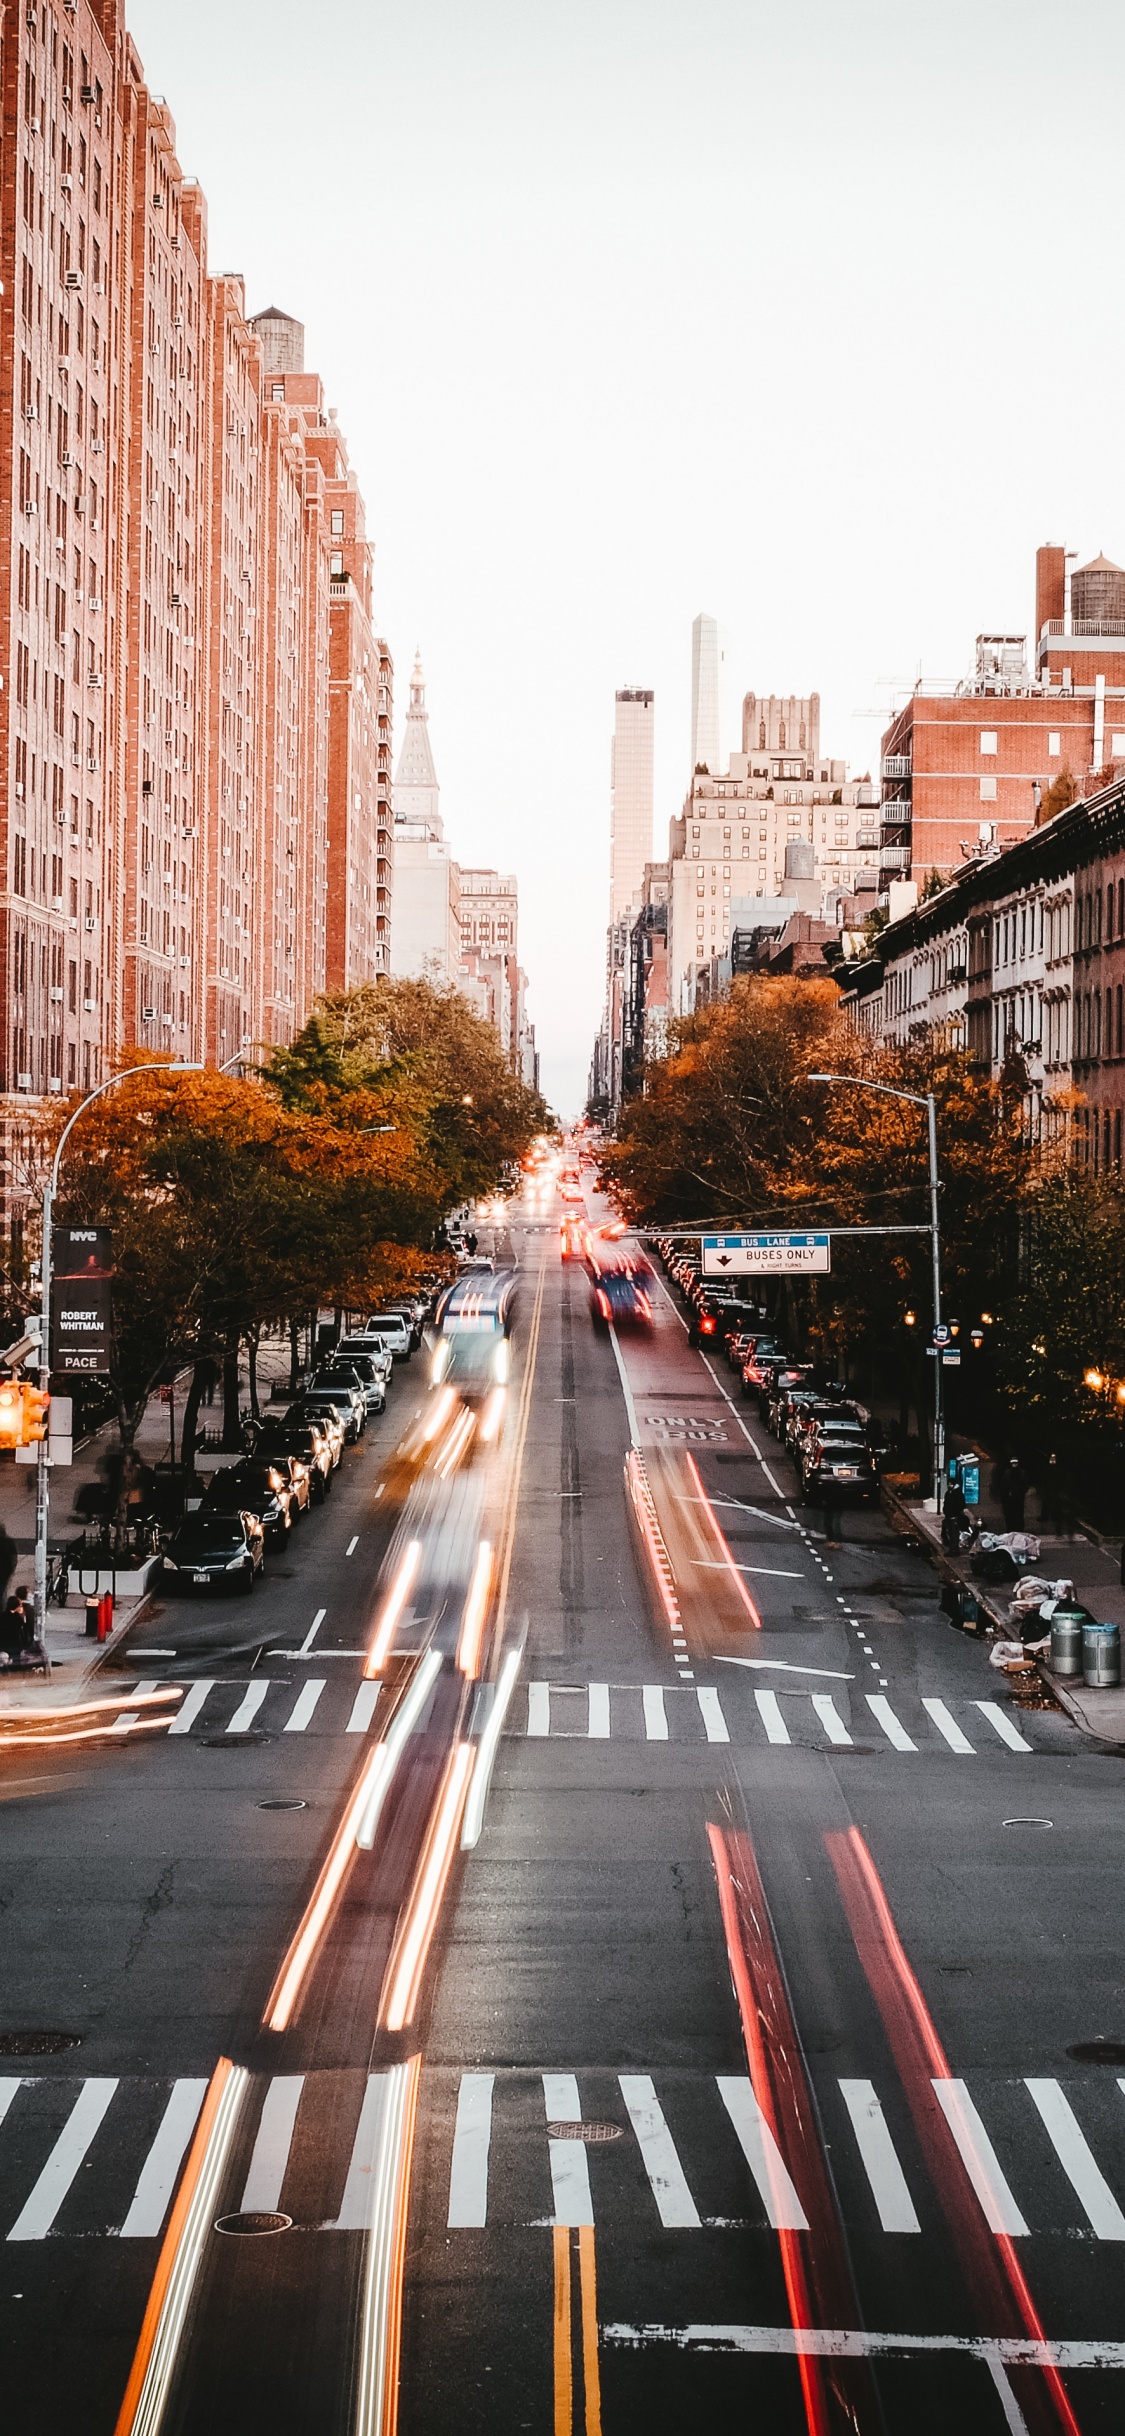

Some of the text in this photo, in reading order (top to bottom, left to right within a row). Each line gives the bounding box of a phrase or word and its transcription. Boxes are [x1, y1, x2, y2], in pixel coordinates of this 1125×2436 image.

[70, 1231, 97, 1242] NYC
[741, 1237, 791, 1247] BUS LANE
[746, 1249, 815, 1260] BUSES ONLY
[60, 1311, 98, 1321] ROBERT
[60, 1321, 104, 1331] WHITMAN
[65, 1357, 98, 1368] PACE
[646, 1417, 728, 1428] ONLY
[662, 1431, 729, 1442] BUS
